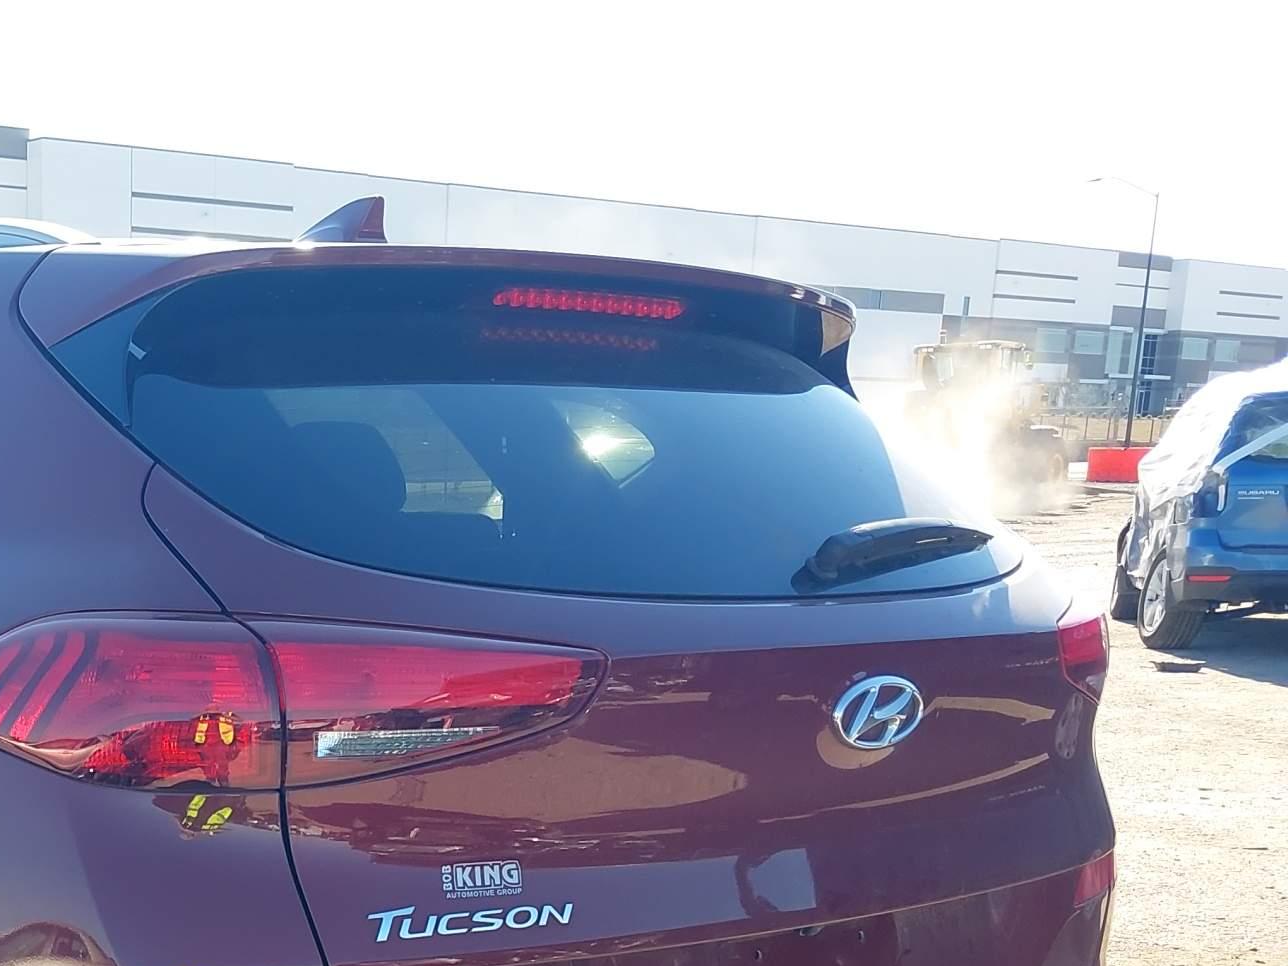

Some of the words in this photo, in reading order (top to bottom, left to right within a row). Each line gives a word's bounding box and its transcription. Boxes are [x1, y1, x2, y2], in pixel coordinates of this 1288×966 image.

[442, 865, 453, 891] BOB
[455, 863, 520, 888] KING
[446, 889, 495, 899] AUTOMOTIVE
[496, 887, 523, 896] GROUP
